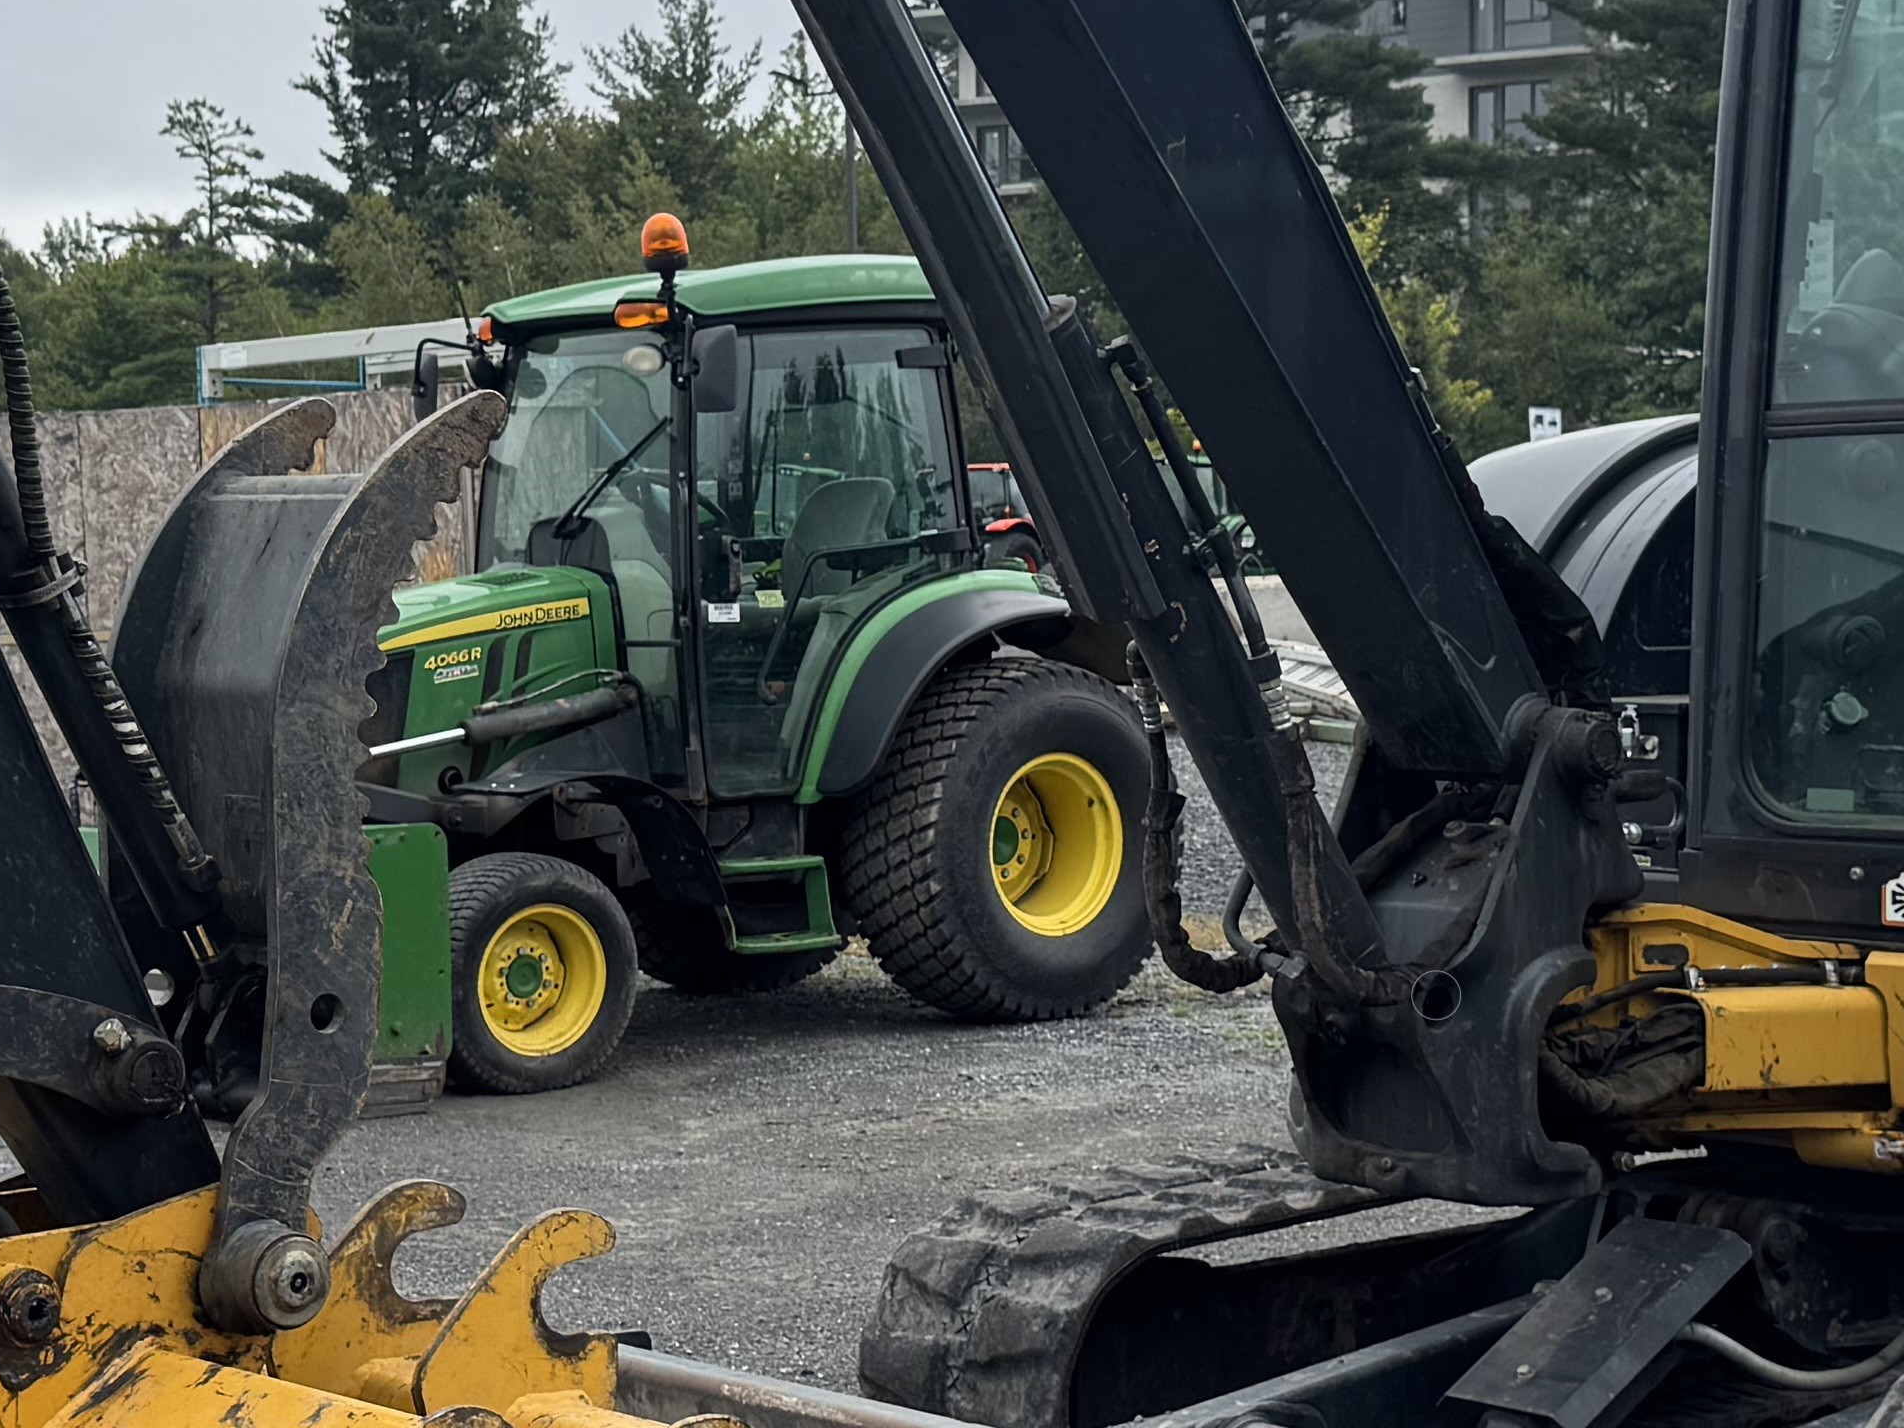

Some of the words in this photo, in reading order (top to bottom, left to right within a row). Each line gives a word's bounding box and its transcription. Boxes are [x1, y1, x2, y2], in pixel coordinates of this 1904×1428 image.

[496, 611, 534, 629] JOHN
[536, 604, 580, 622] DEERE
[424, 647, 482, 670] 4066R
